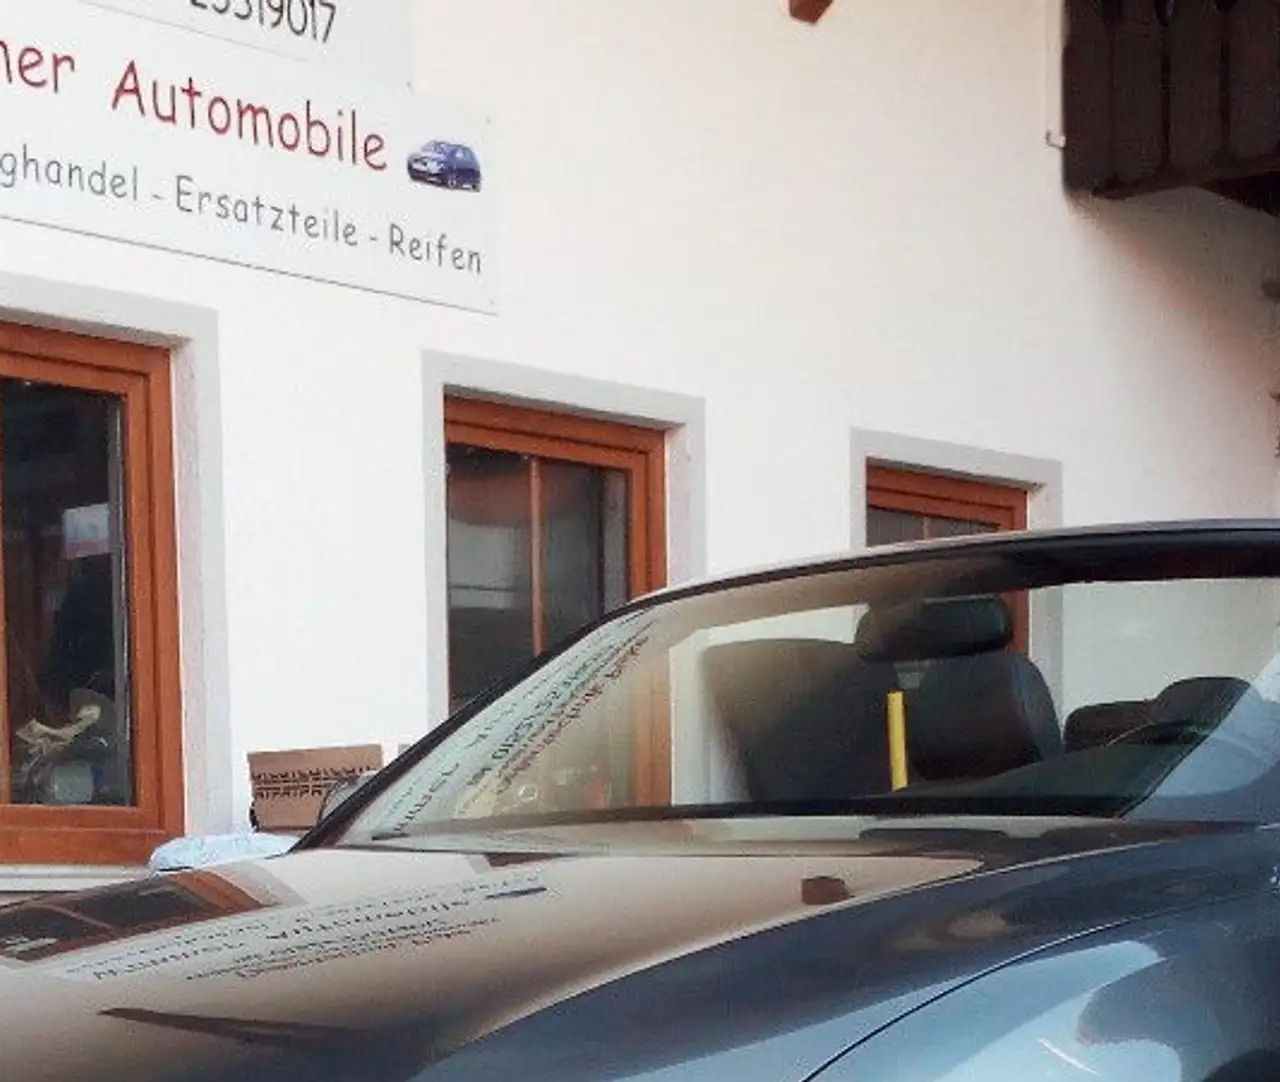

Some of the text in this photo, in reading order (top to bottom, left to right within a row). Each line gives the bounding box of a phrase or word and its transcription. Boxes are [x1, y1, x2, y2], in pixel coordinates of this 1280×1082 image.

[189, 0, 337, 43] 19017
[111, 59, 388, 171] Automobile
[176, 174, 358, 247] Ersatzteile
[389, 223, 481, 274] Reifen
